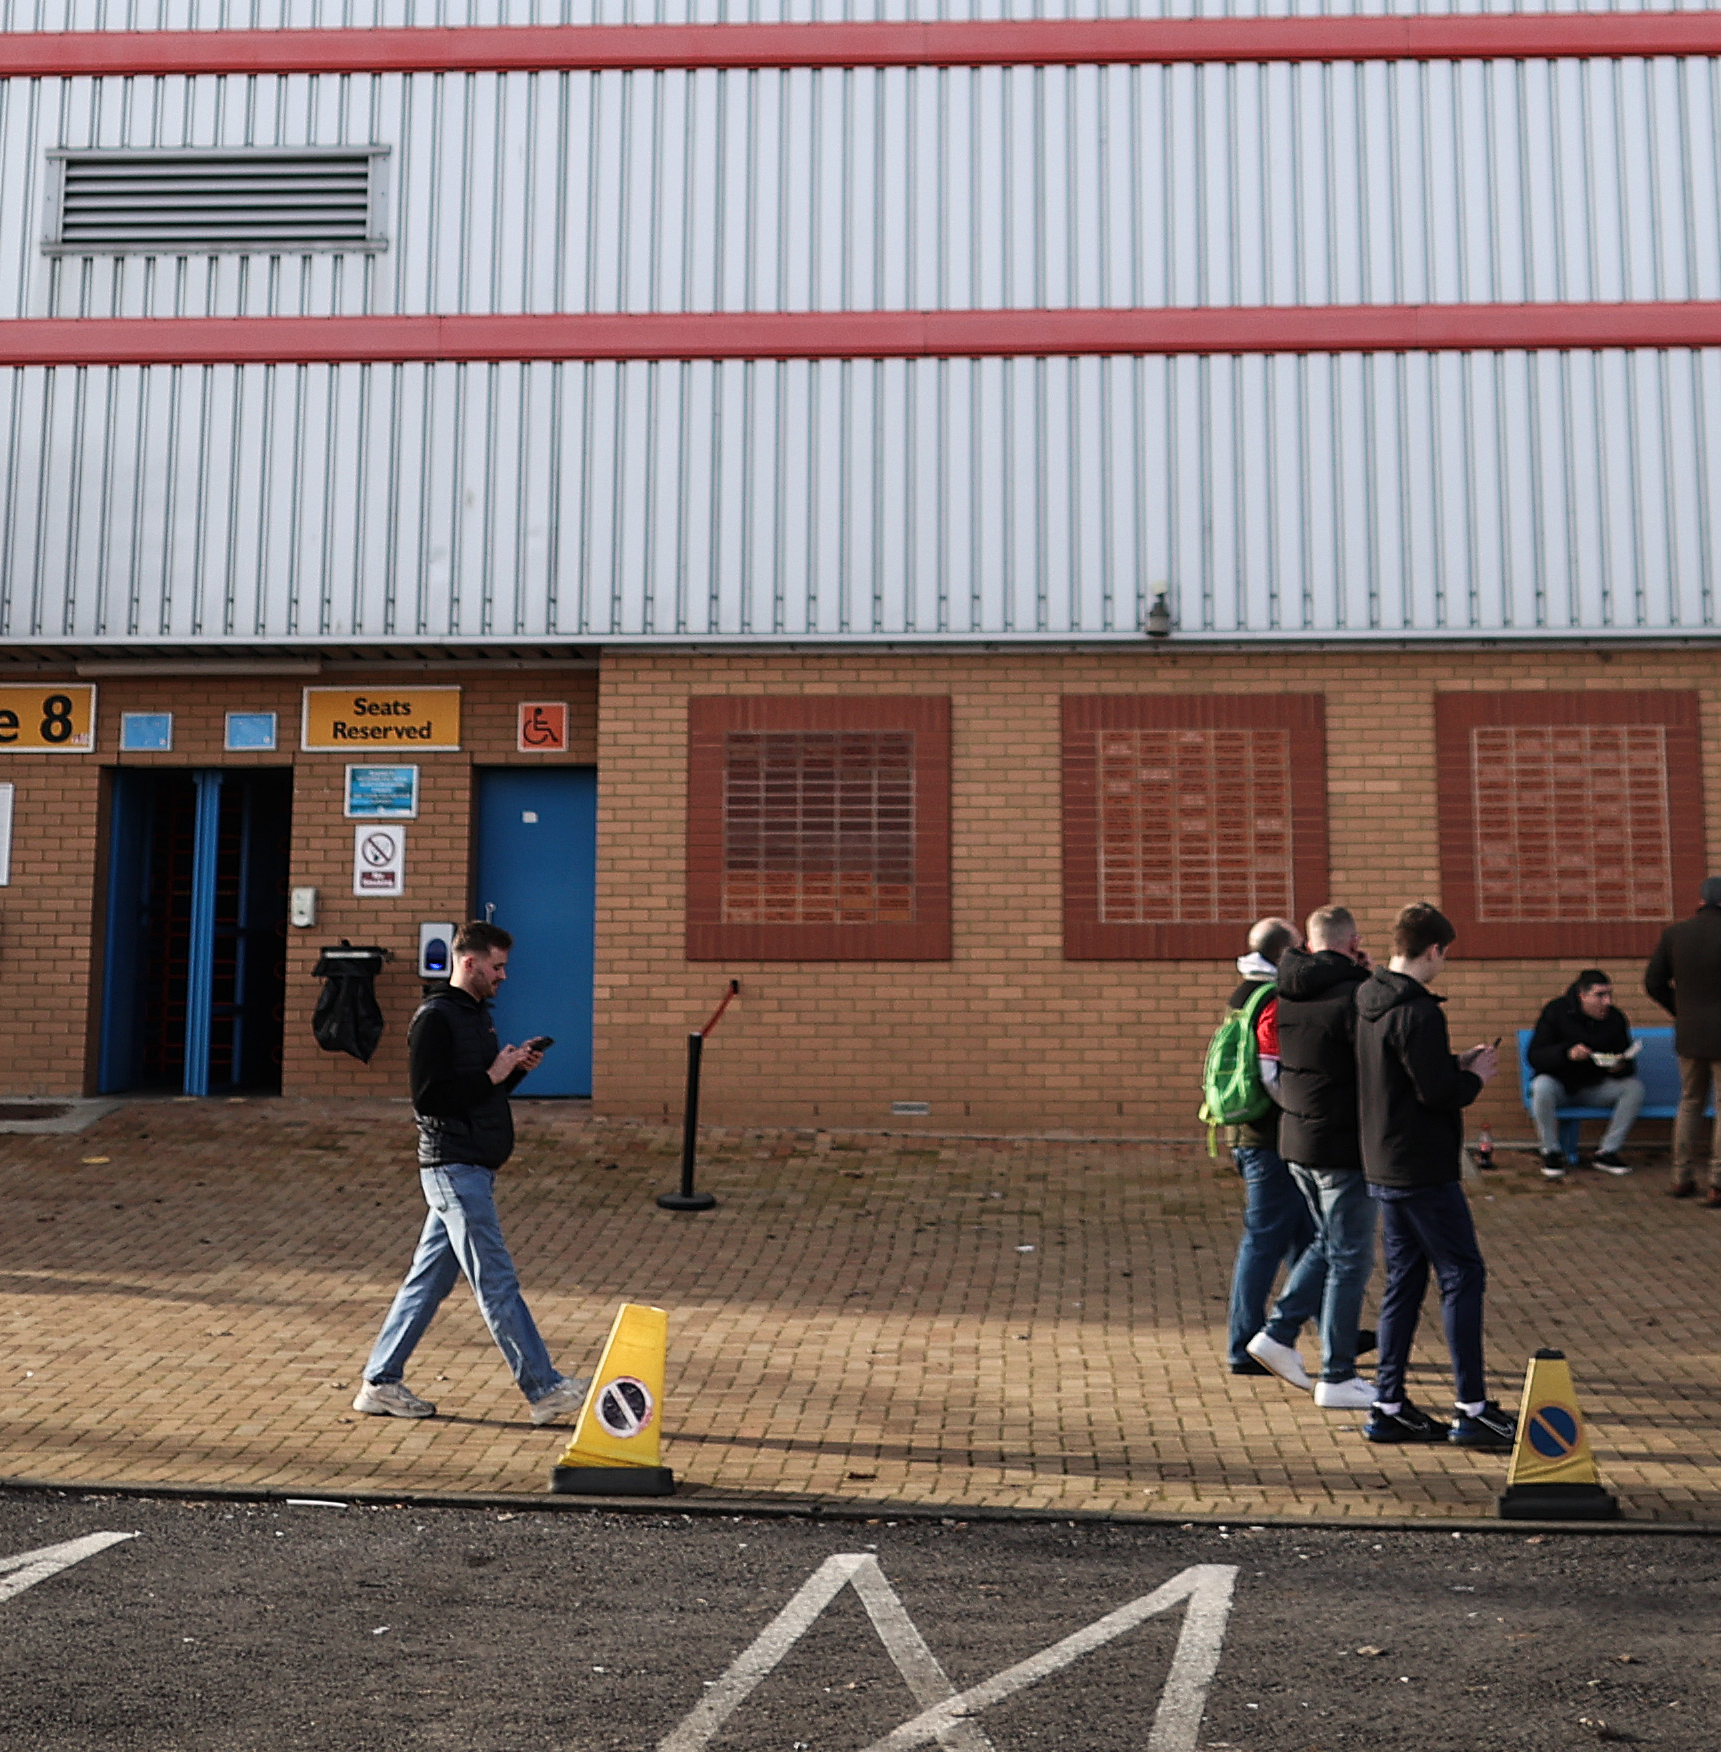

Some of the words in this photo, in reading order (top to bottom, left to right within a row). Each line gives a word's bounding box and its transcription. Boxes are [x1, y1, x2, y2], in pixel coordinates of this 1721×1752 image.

[353, 696, 412, 717] Seats
[39, 693, 74, 745] 8
[332, 720, 432, 740] Reserved
